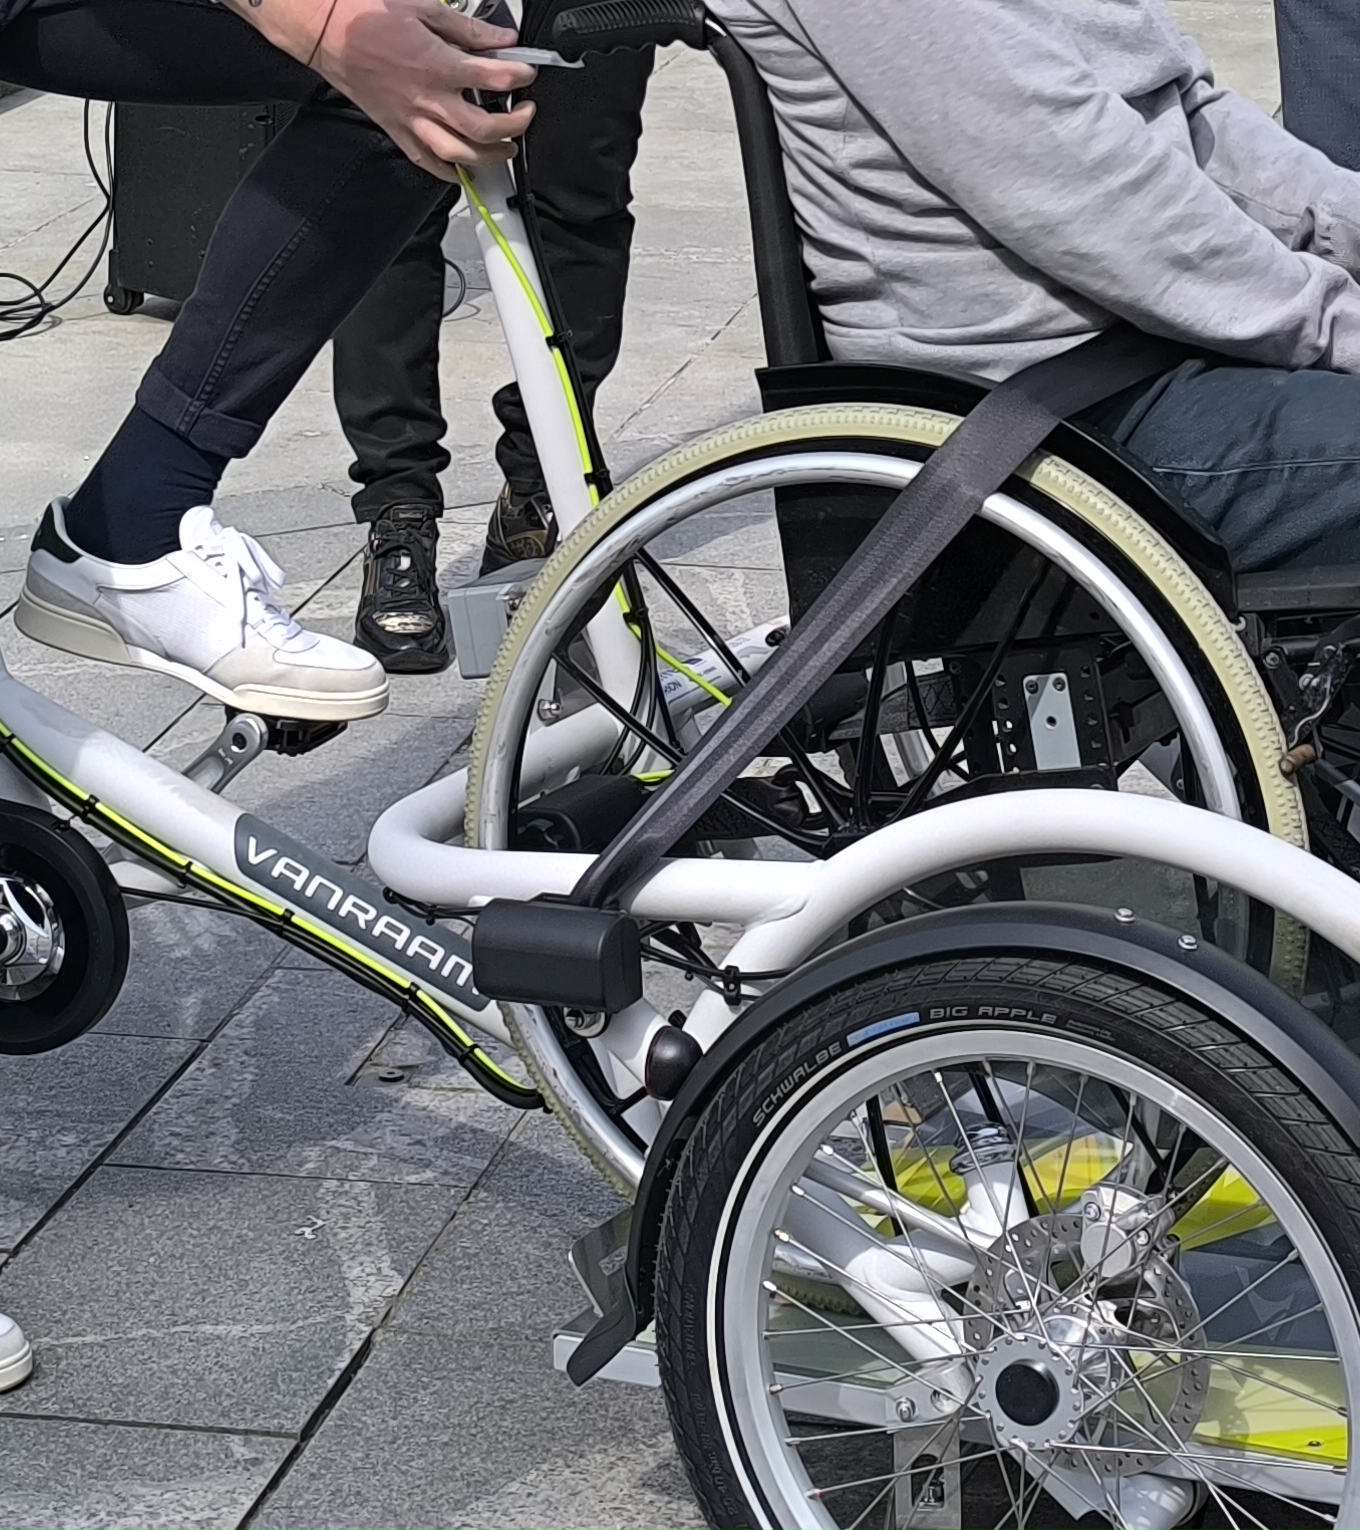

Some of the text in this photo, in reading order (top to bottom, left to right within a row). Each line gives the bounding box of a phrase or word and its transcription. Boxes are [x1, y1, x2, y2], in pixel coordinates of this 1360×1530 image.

[751, 1005, 1058, 1128] SCHWALBE BIG APPLE
